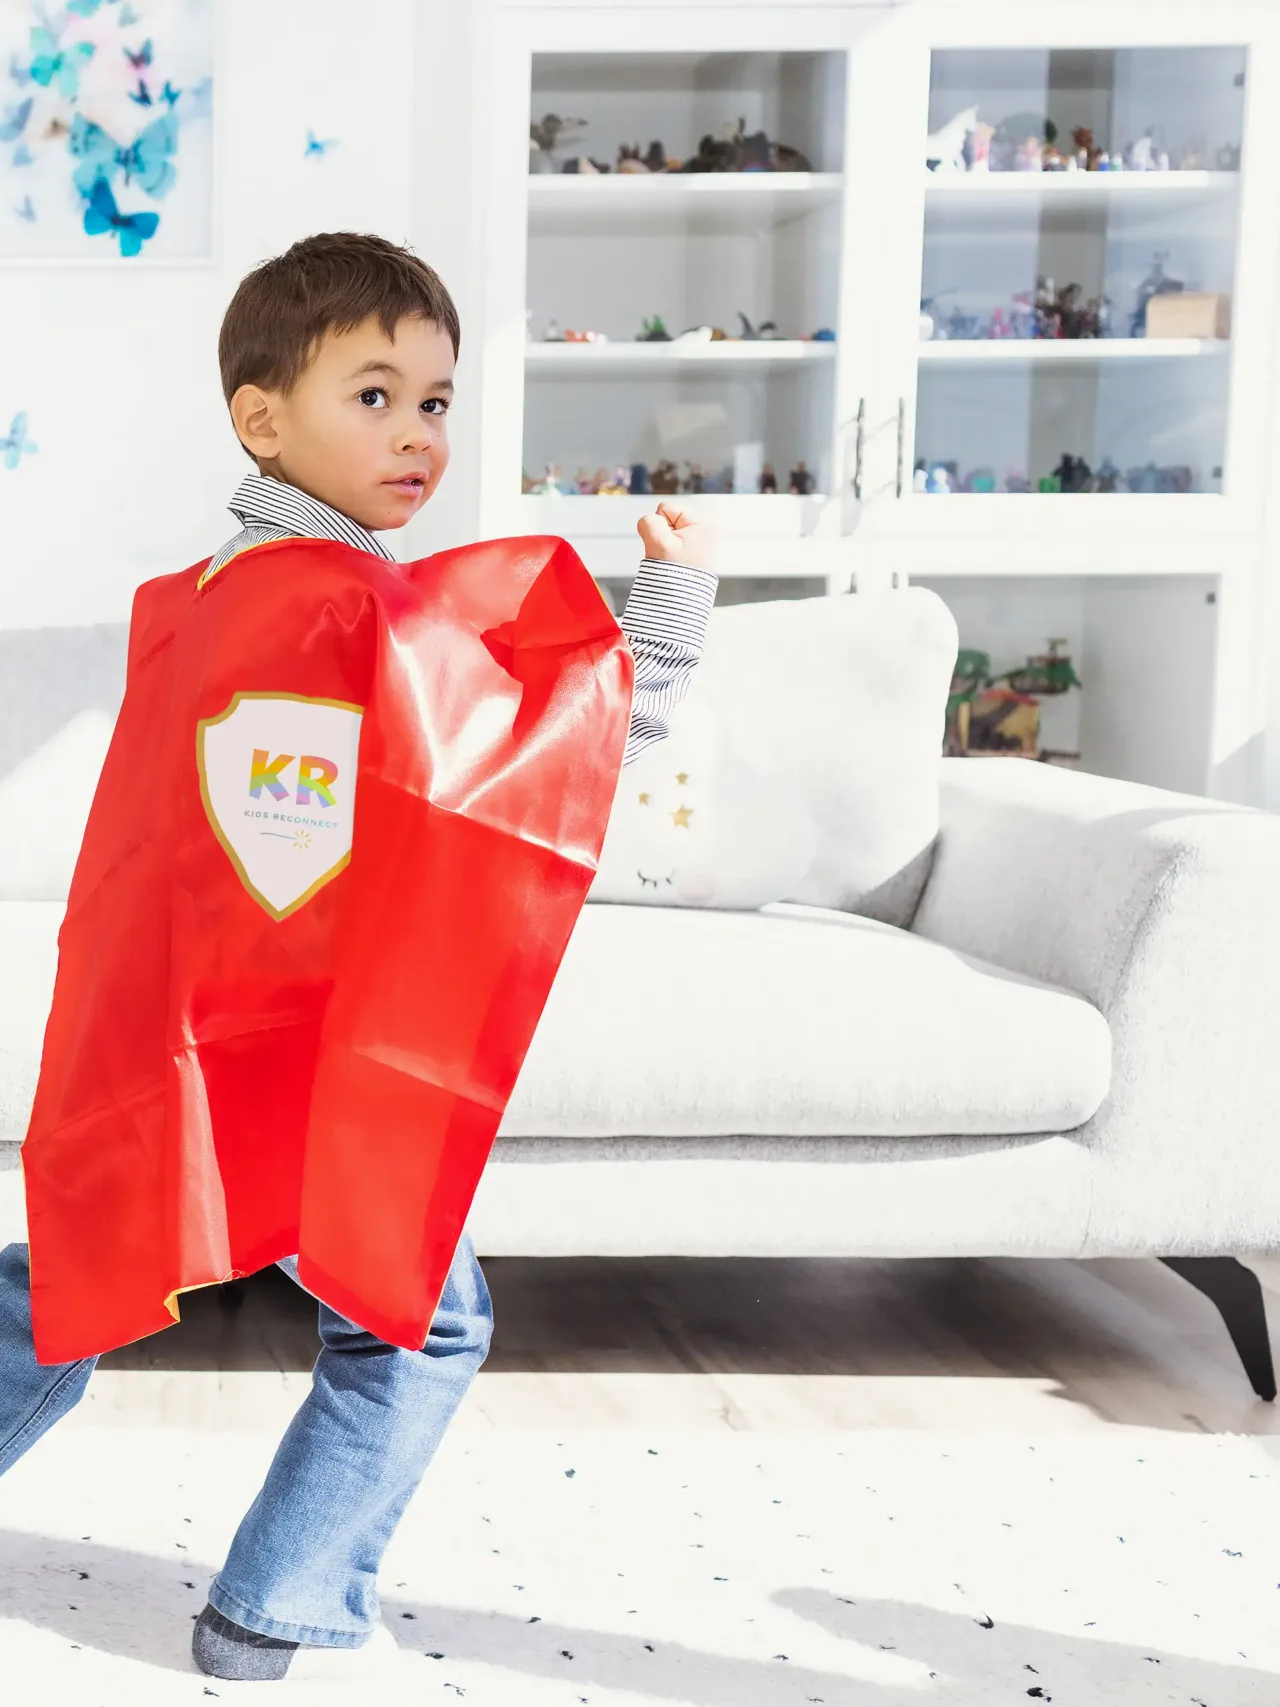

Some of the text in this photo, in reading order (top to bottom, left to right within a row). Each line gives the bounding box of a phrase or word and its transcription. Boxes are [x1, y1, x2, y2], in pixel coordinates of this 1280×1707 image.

[249, 748, 339, 809] KR
[244, 810, 338, 828] KIDS RECONNECT
